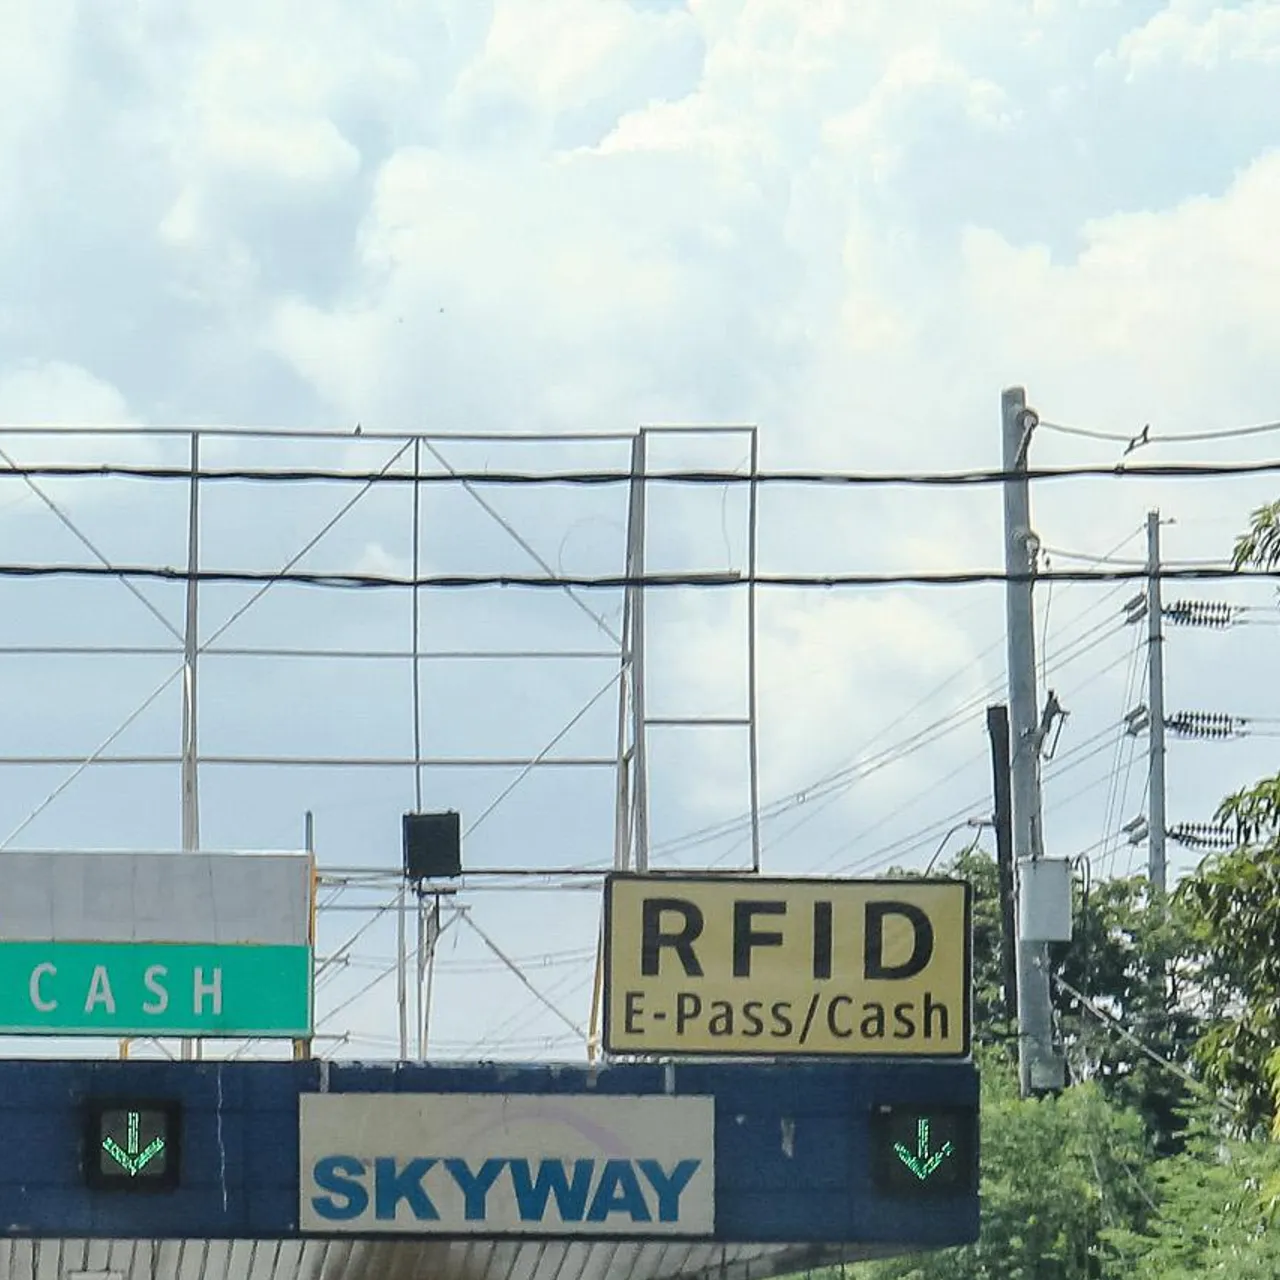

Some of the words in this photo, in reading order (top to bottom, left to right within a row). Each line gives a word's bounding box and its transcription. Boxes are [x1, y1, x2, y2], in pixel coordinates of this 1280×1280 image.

[641, 898, 935, 981] RFID
[28, 961, 223, 1016] CASH
[623, 991, 949, 1045] E-Pass/Cash
[310, 1154, 702, 1224] SKYWAY
